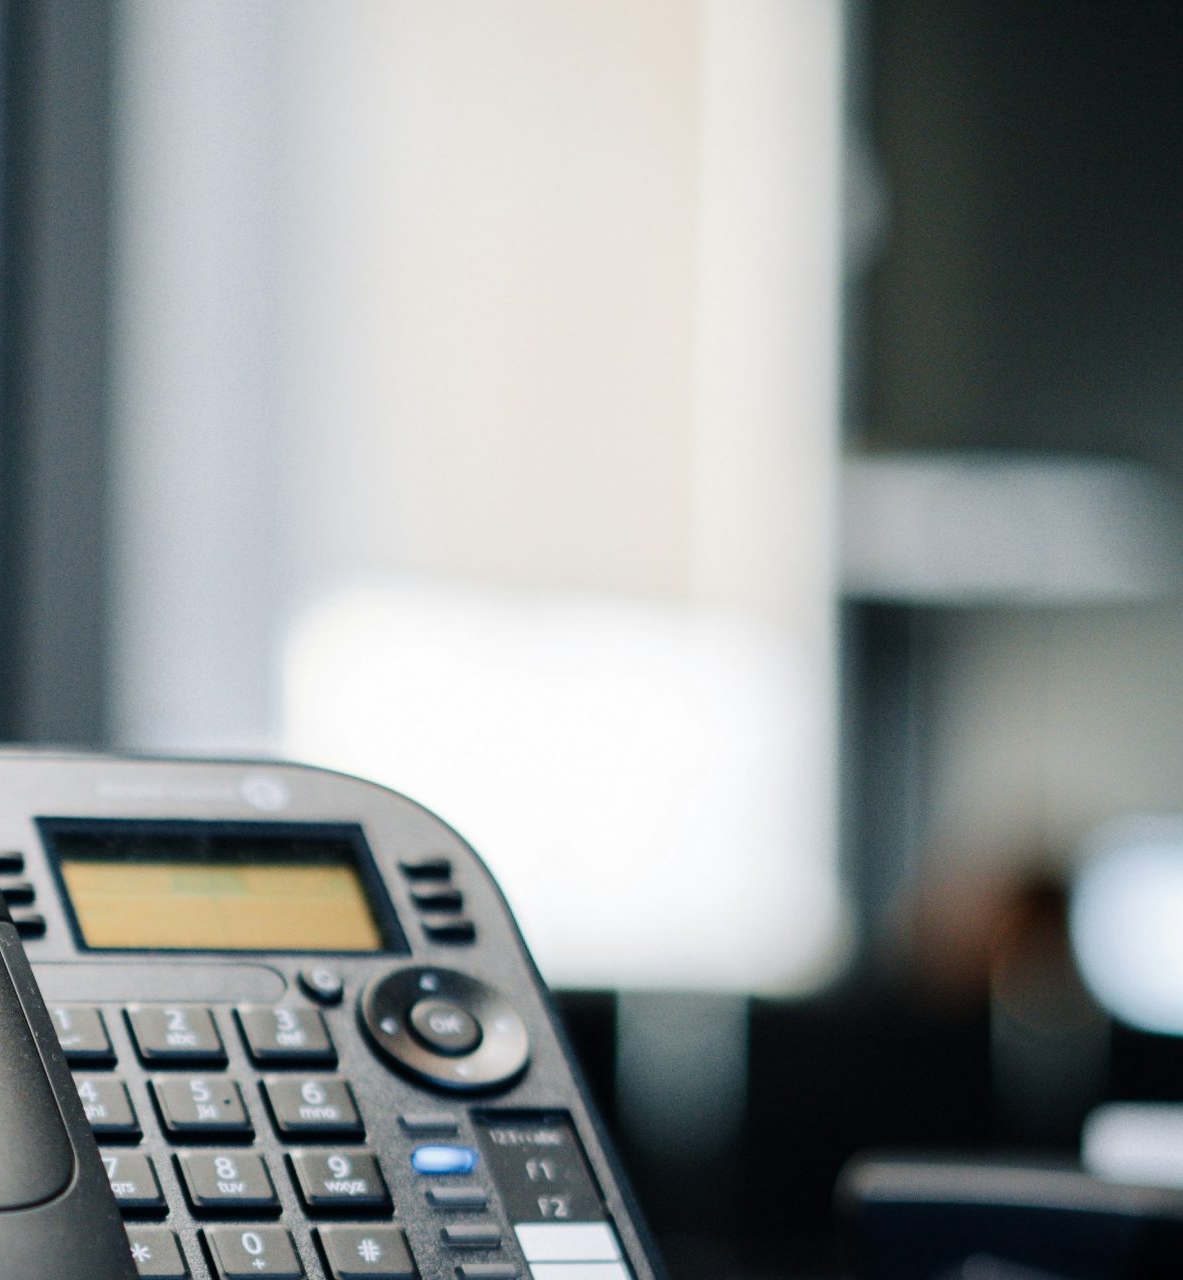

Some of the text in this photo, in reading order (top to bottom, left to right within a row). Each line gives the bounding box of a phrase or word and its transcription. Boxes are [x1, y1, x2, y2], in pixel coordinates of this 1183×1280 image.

[55, 1009, 70, 1030] 1
[164, 1009, 187, 1031] 2
[275, 1008, 295, 1031] 3
[429, 1015, 462, 1034] OK
[77, 1080, 98, 1102] 4
[191, 1080, 209, 1102] 5
[301, 1081, 323, 1105] 6
[299, 1106, 338, 1120] mno
[102, 1157, 118, 1179] 7
[214, 1157, 237, 1180] 8
[327, 1156, 349, 1179] 9
[524, 1160, 554, 1181] F1
[111, 1182, 136, 1197] qrs
[218, 1181, 245, 1193] tuv
[324, 1181, 367, 1197] wxyz
[537, 1197, 568, 1218] F2
[241, 1232, 263, 1256] 0
[357, 1239, 380, 1263] #
